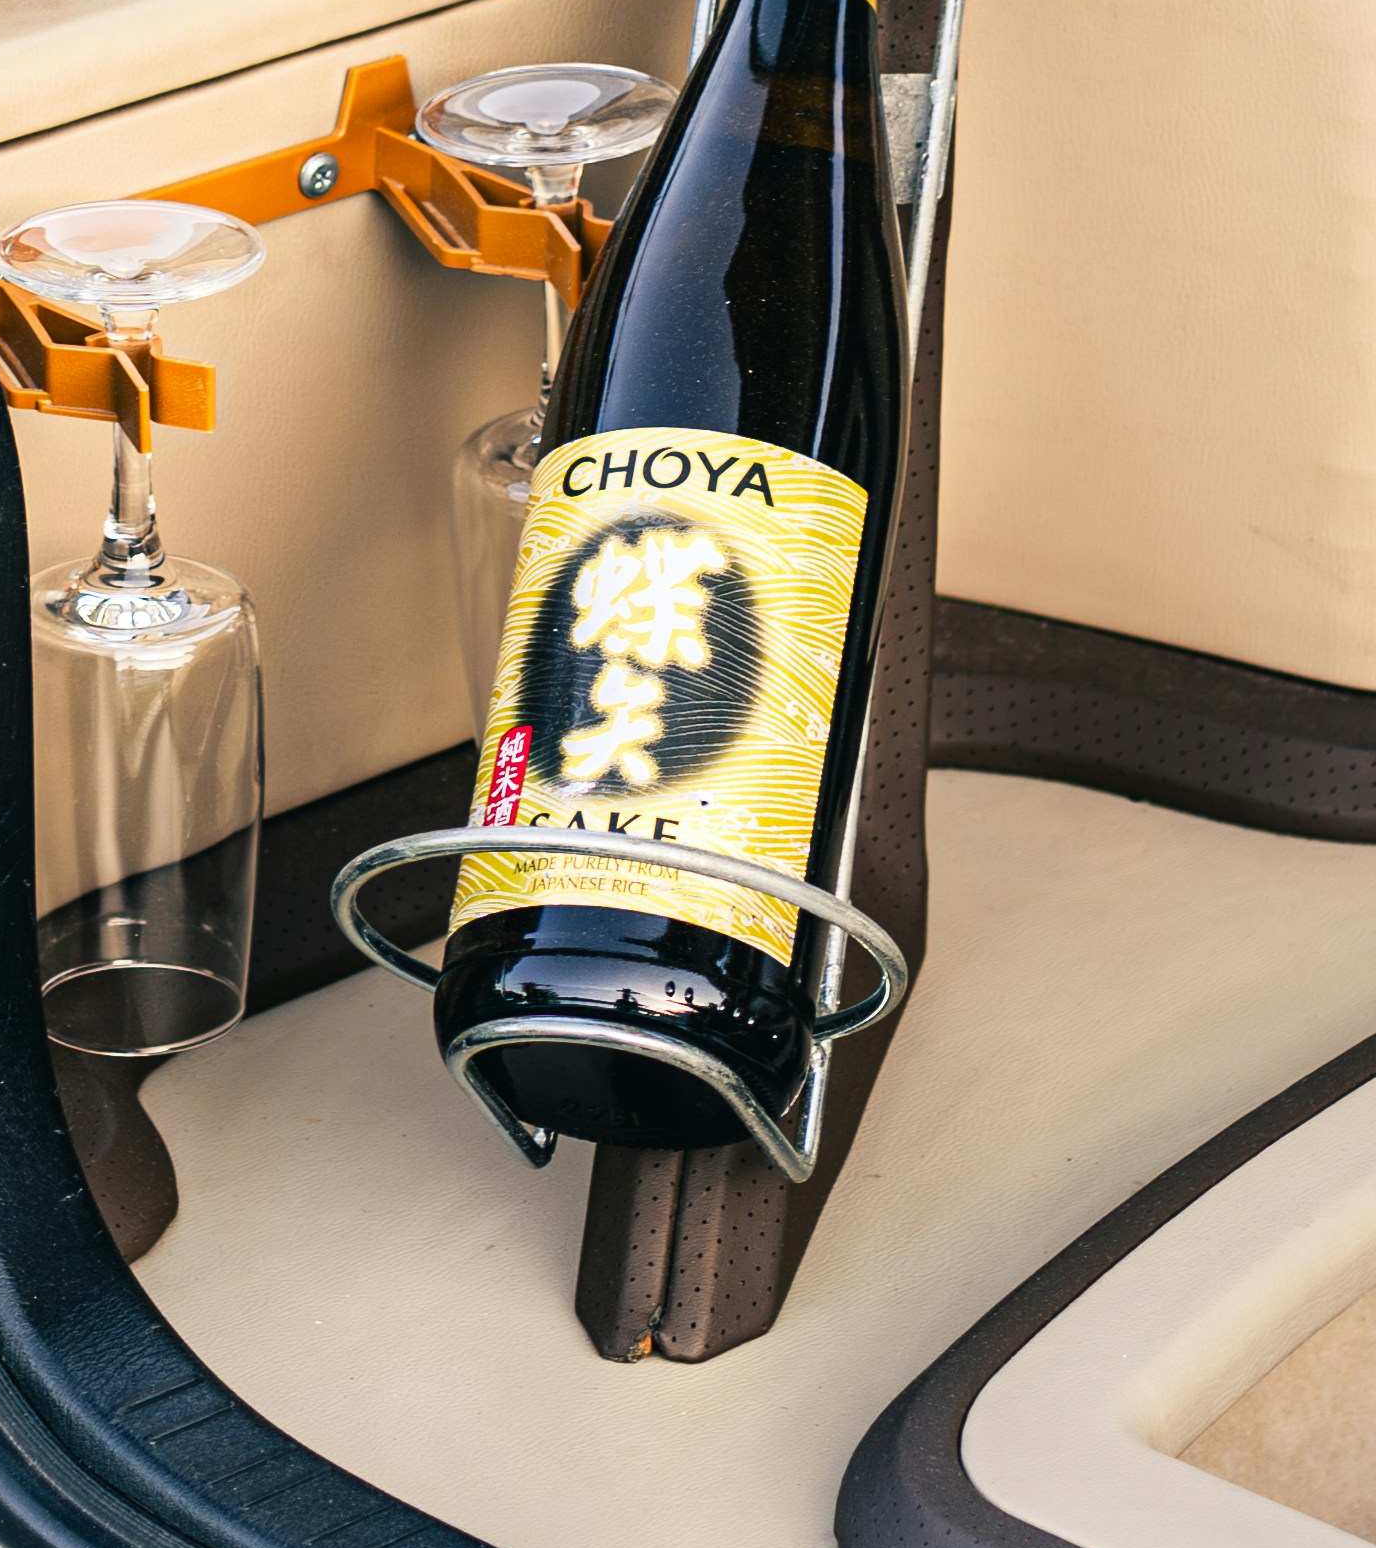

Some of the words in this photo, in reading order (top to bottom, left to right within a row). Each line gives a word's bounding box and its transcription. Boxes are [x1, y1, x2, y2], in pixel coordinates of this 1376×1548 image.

[561, 446, 775, 508] CHOYA
[486, 731, 527, 827] 純米酒
[513, 856, 557, 875] MADE
[563, 856, 625, 873] PURELY
[627, 860, 680, 882] FROM
[531, 876, 604, 893] JAPANESE
[610, 878, 651, 897] RICE
